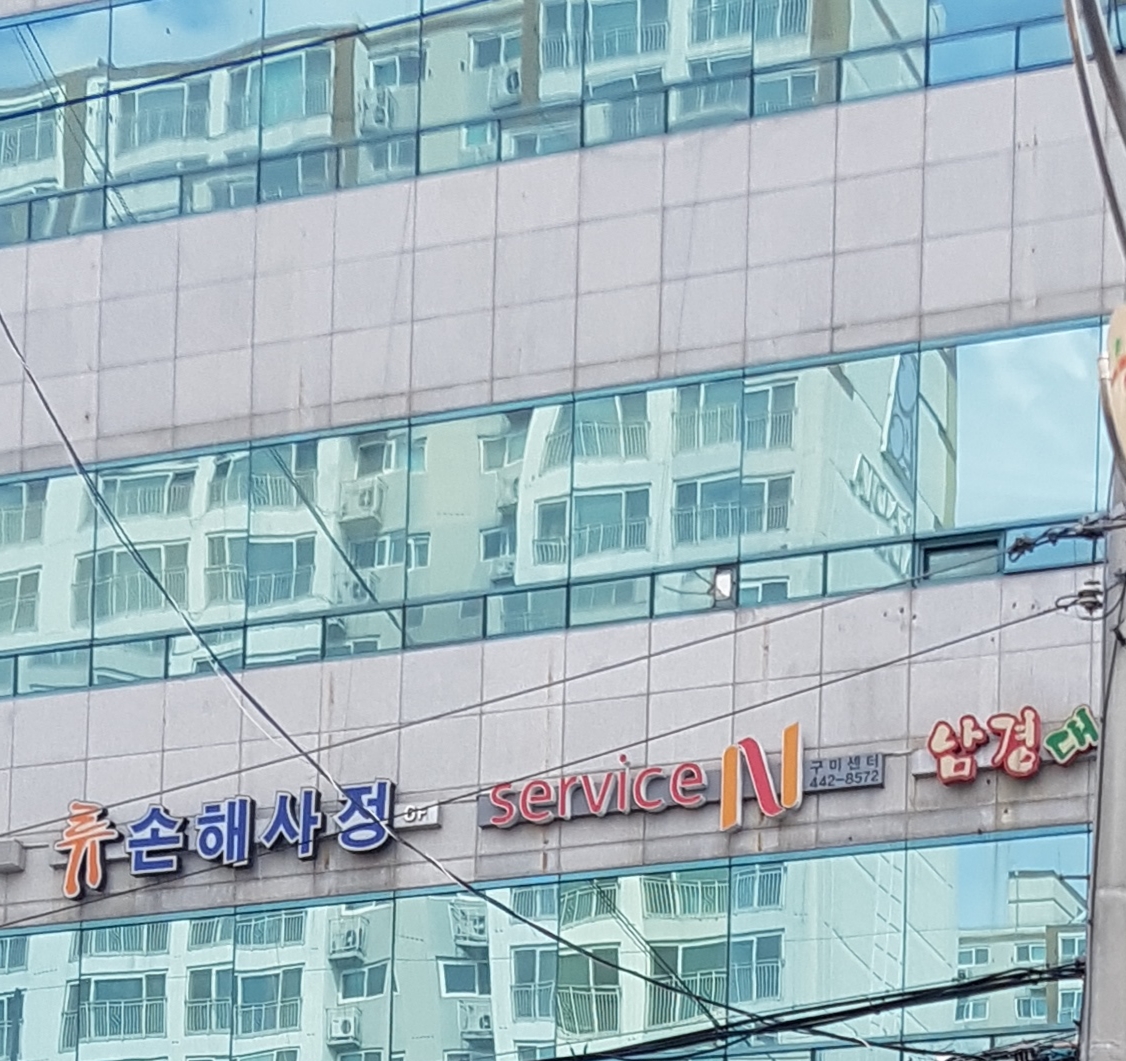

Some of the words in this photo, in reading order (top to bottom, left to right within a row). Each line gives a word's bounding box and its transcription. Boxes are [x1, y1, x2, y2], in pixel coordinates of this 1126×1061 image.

[809, 754, 879, 775] 구미센터
[809, 770, 880, 788] 442-8572
[489, 753, 708, 827] service
